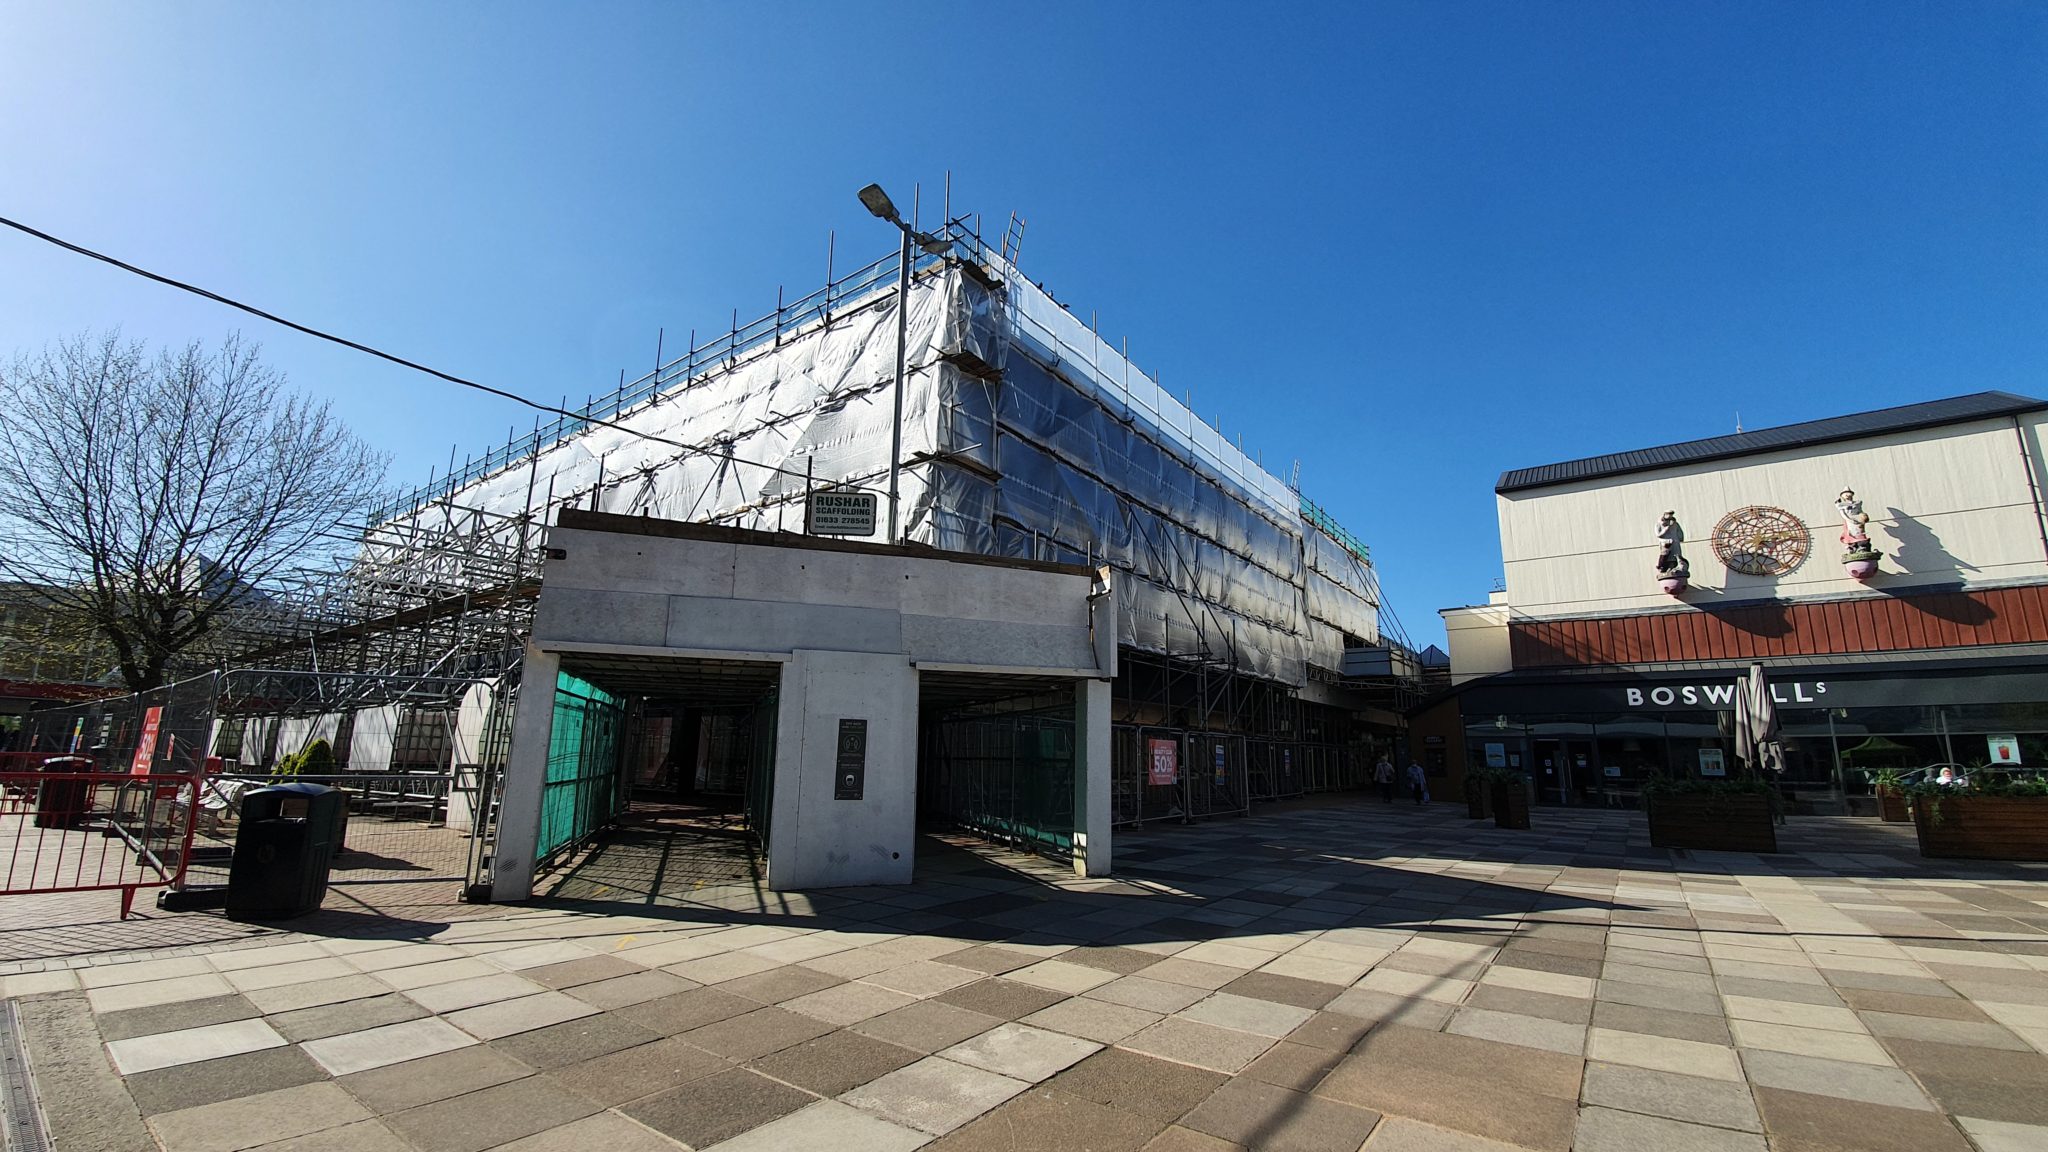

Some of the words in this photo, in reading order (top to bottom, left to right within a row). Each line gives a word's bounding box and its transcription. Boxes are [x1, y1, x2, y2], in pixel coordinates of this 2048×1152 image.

[816, 496, 870, 507] RUSHAR
[816, 507, 870, 515] SCAFFOLDING
[1626, 682, 1827, 706] BOSWLLS
[1154, 755, 1172, 772] 50%
